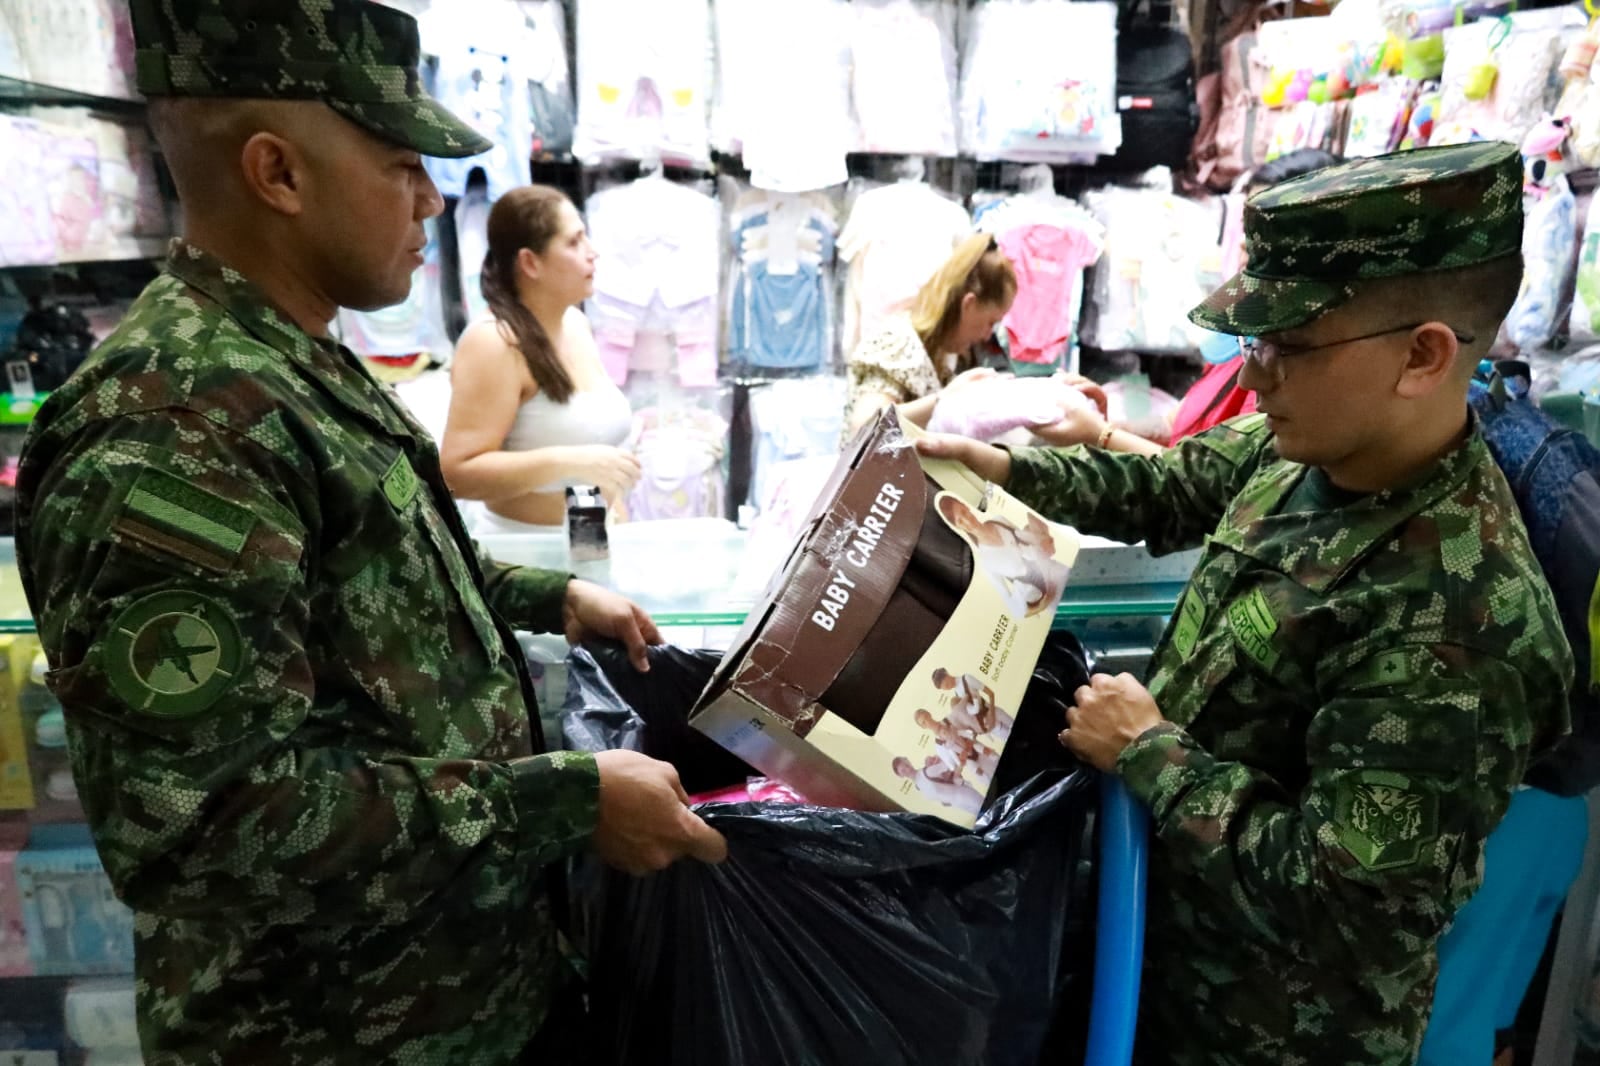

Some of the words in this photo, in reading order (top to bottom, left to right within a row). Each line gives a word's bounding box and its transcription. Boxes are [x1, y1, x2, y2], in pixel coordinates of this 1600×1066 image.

[811, 569, 856, 632] BABY
[846, 482, 905, 568] CARRIER
[979, 650, 993, 674] BABY
[988, 614, 1009, 650] CARRIER
[1380, 788, 1393, 807] 2
